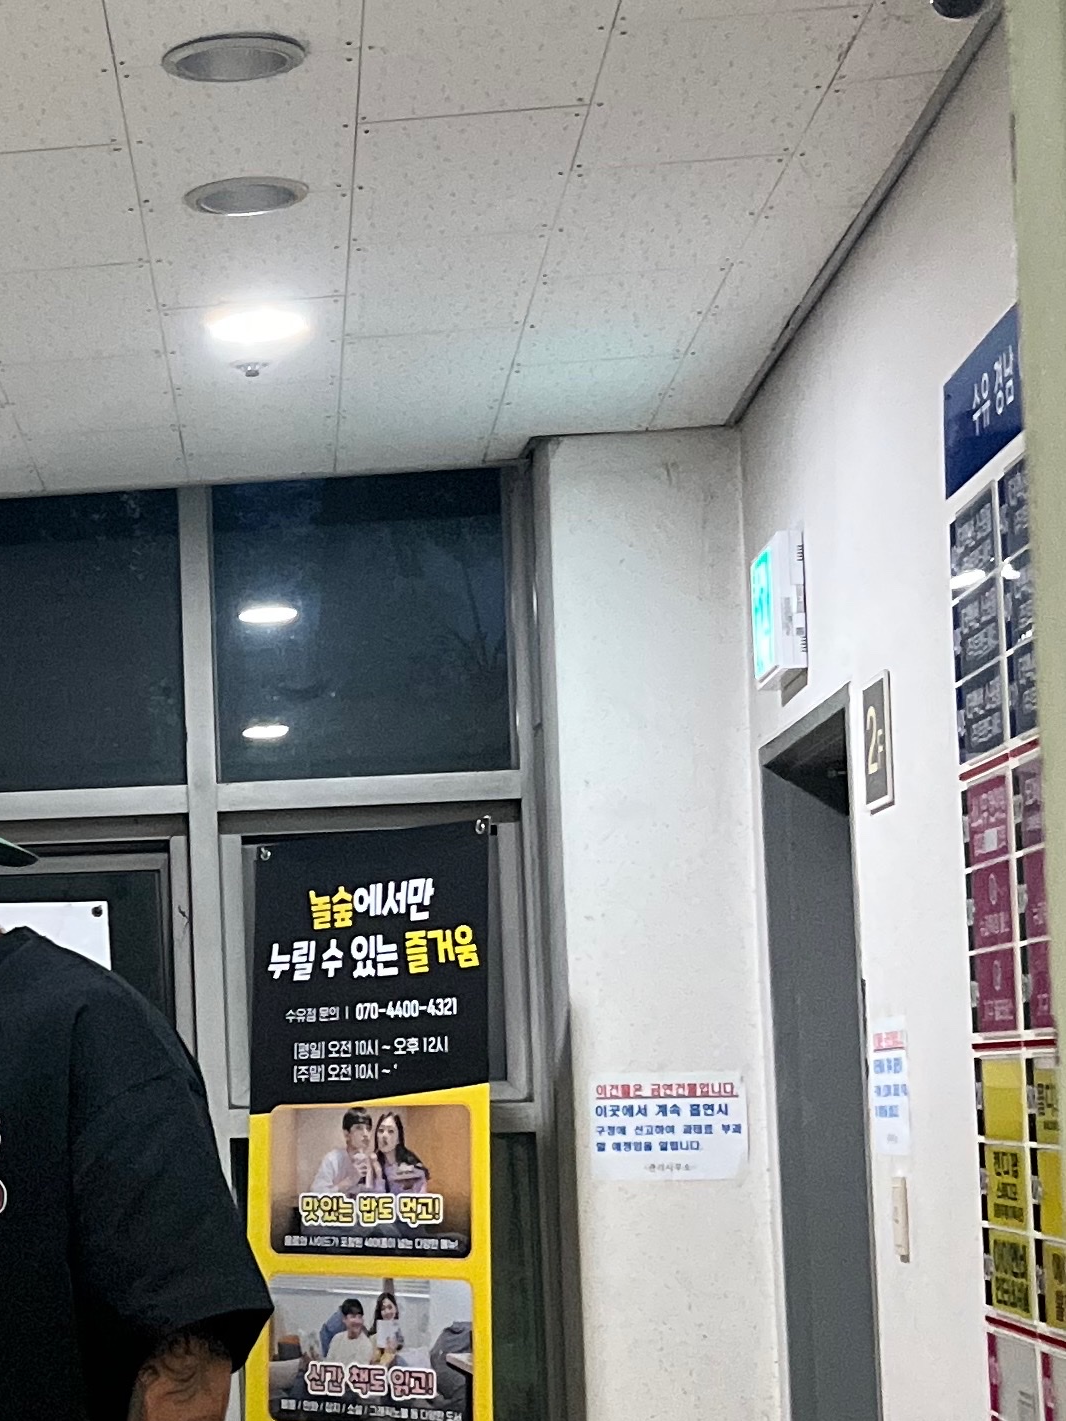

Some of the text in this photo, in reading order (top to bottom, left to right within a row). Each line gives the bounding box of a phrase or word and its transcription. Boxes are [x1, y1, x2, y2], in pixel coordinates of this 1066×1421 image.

[972, 372, 991, 436] 수유
[866, 705, 884, 775] 2F
[308, 877, 435, 930] 놀숲에서만
[267, 924, 480, 982] 누릴 수 있는 즐거움
[285, 1008, 317, 1023] 수유점
[319, 1006, 340, 1022] 문의
[355, 997, 458, 1021] 070-4400-4321
[293, 1041, 326, 1060] [평일]
[327, 1040, 352, 1058] 오전
[355, 1039, 379, 1056] 10시
[394, 1037, 419, 1055] 오후
[423, 1035, 449, 1053] 12시
[293, 1064, 326, 1083] [주말]
[327, 1063, 352, 1081] 오전
[355, 1063, 379, 1080] 10시
[595, 1103, 729, 1118] 이곳에서 계속 흡연시
[301, 1194, 441, 1225] 맛있는 밥도 먹고!
[306, 1364, 435, 1397] 신간 책도 읽고!
